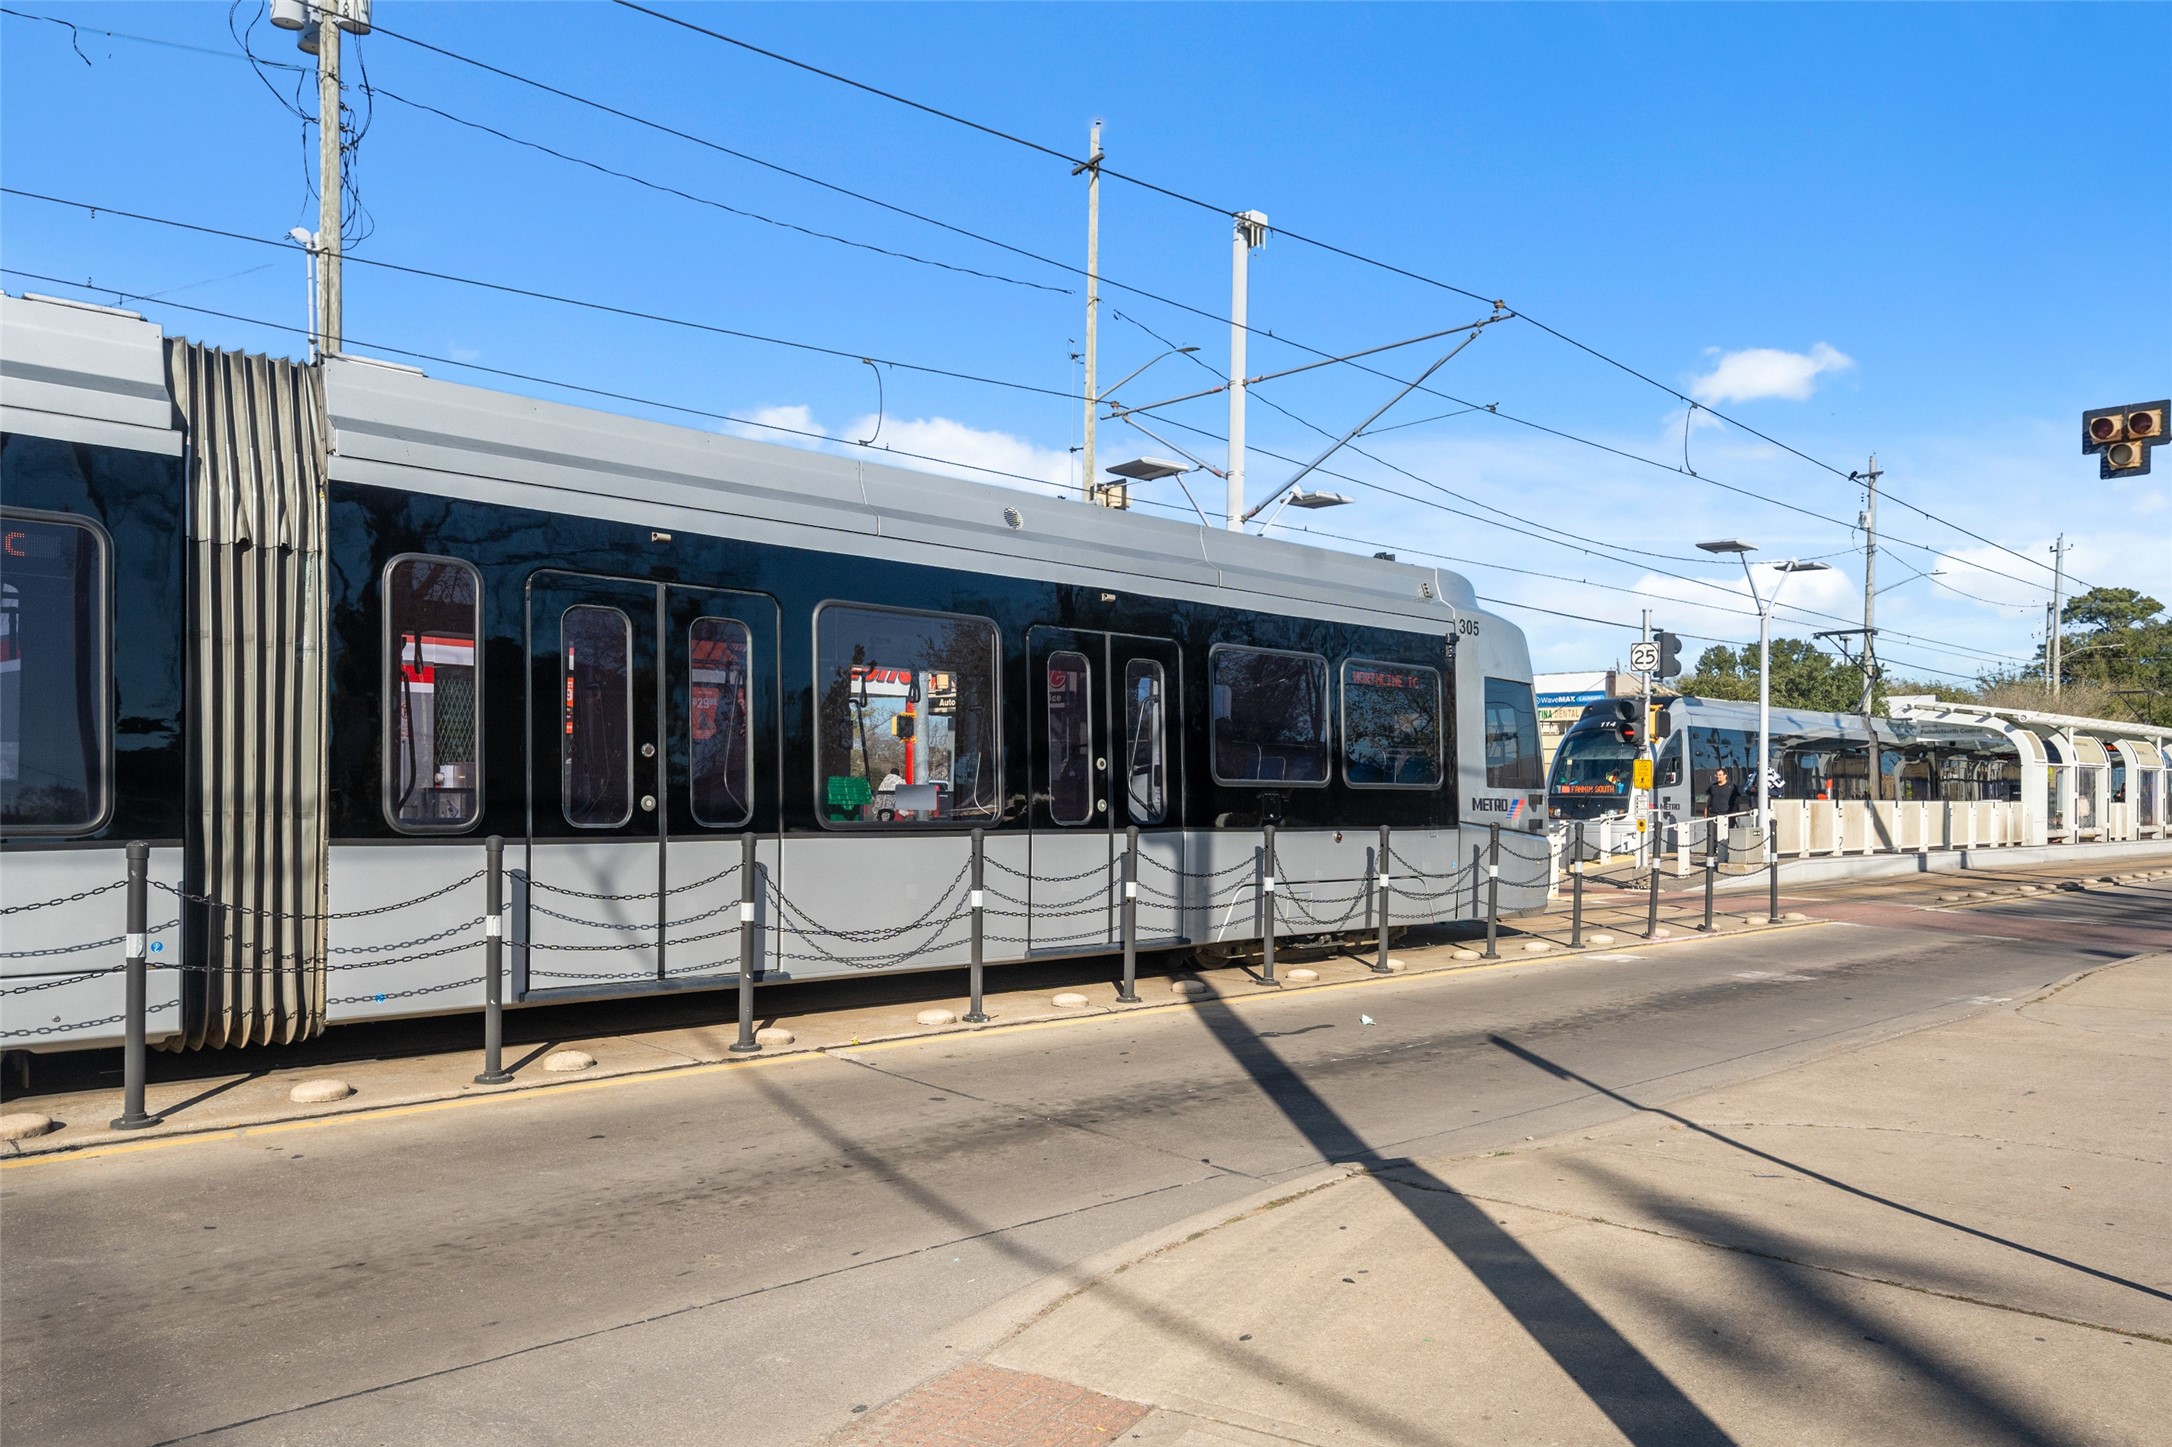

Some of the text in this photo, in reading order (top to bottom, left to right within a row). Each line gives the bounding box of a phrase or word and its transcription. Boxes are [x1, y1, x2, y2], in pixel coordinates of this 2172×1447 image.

[1459, 618, 1480, 636] 305
[1634, 649, 1656, 665] 25
[939, 698, 956, 707] Auto
[1541, 695, 1576, 704] WaveMAX
[1554, 708, 1580, 719] DENTAL
[1595, 785, 1615, 793] SOUTH
[1472, 797, 1508, 812] METRO
